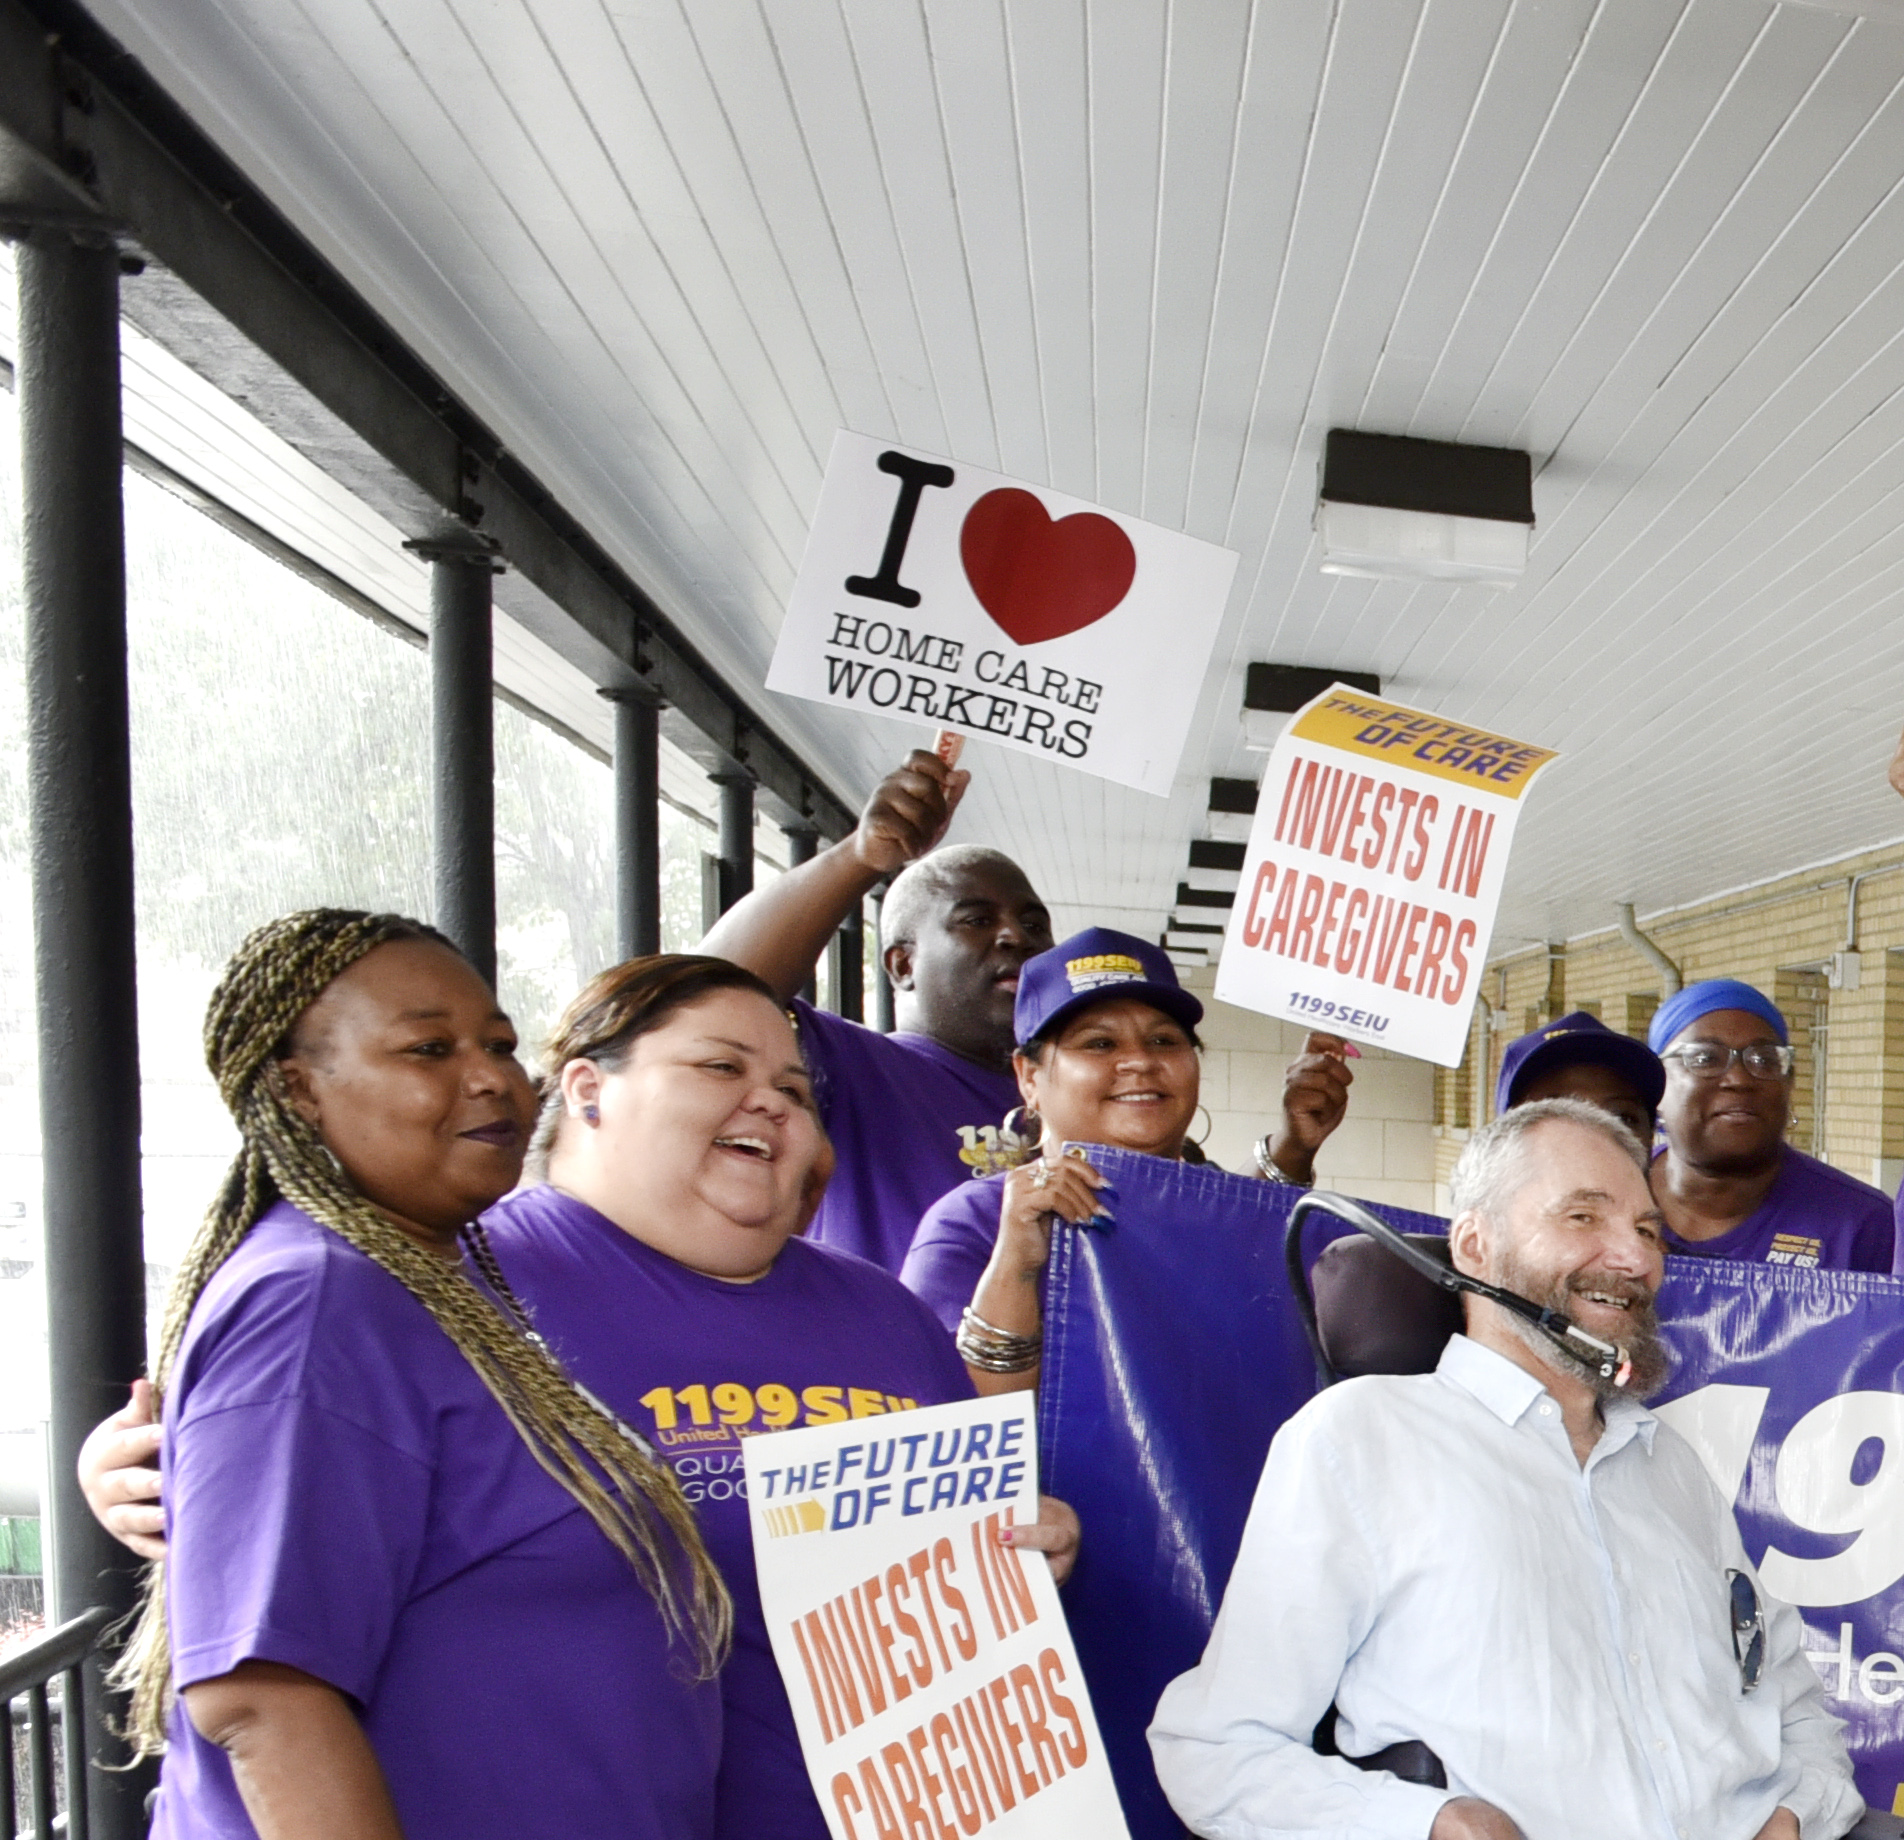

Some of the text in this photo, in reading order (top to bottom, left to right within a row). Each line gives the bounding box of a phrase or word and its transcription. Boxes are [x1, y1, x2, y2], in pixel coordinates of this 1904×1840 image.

[844, 449, 955, 609] I
[826, 612, 1104, 715] HOME CARE
[824, 654, 1093, 760] WORKERS
[1323, 697, 1546, 761] THE FUTURE
[1353, 724, 1528, 783] OF CARE
[1273, 755, 1496, 899] INVESTS IN
[1241, 860, 1478, 1007] CAREGIVERS
[1288, 990, 1391, 1033] 1199SEIU
[1765, 1250, 1820, 1269] PAY US!
[657, 1425, 731, 1447] United
[760, 1417, 1026, 1500] THE FUTURE
[829, 1460, 1027, 1532] OF CARE
[790, 1505, 1039, 1746] INVESTS IN
